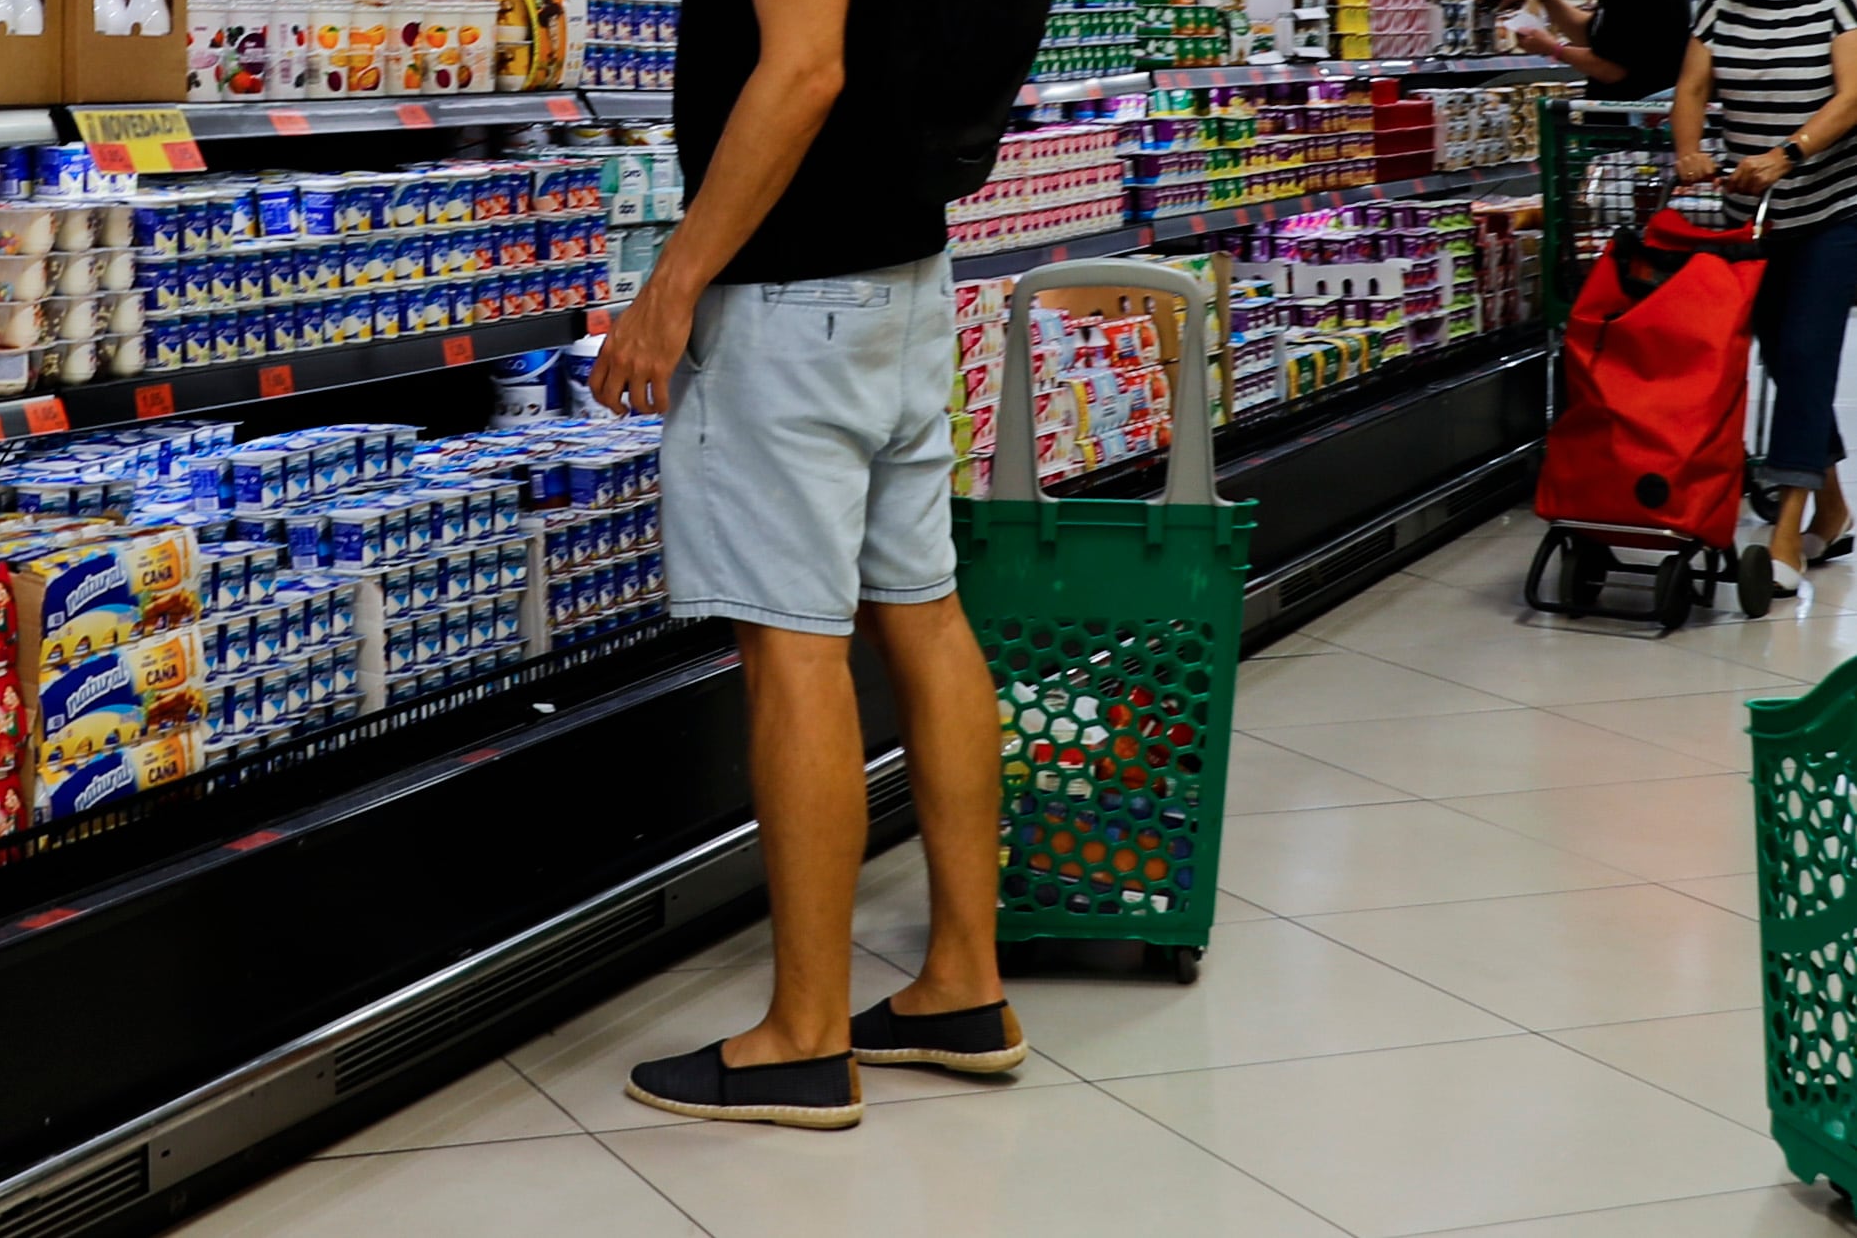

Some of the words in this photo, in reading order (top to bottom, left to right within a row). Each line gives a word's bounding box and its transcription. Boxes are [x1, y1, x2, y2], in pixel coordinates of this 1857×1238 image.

[64, 557, 130, 619] natural
[64, 655, 132, 717] natural
[73, 754, 136, 813] natural
